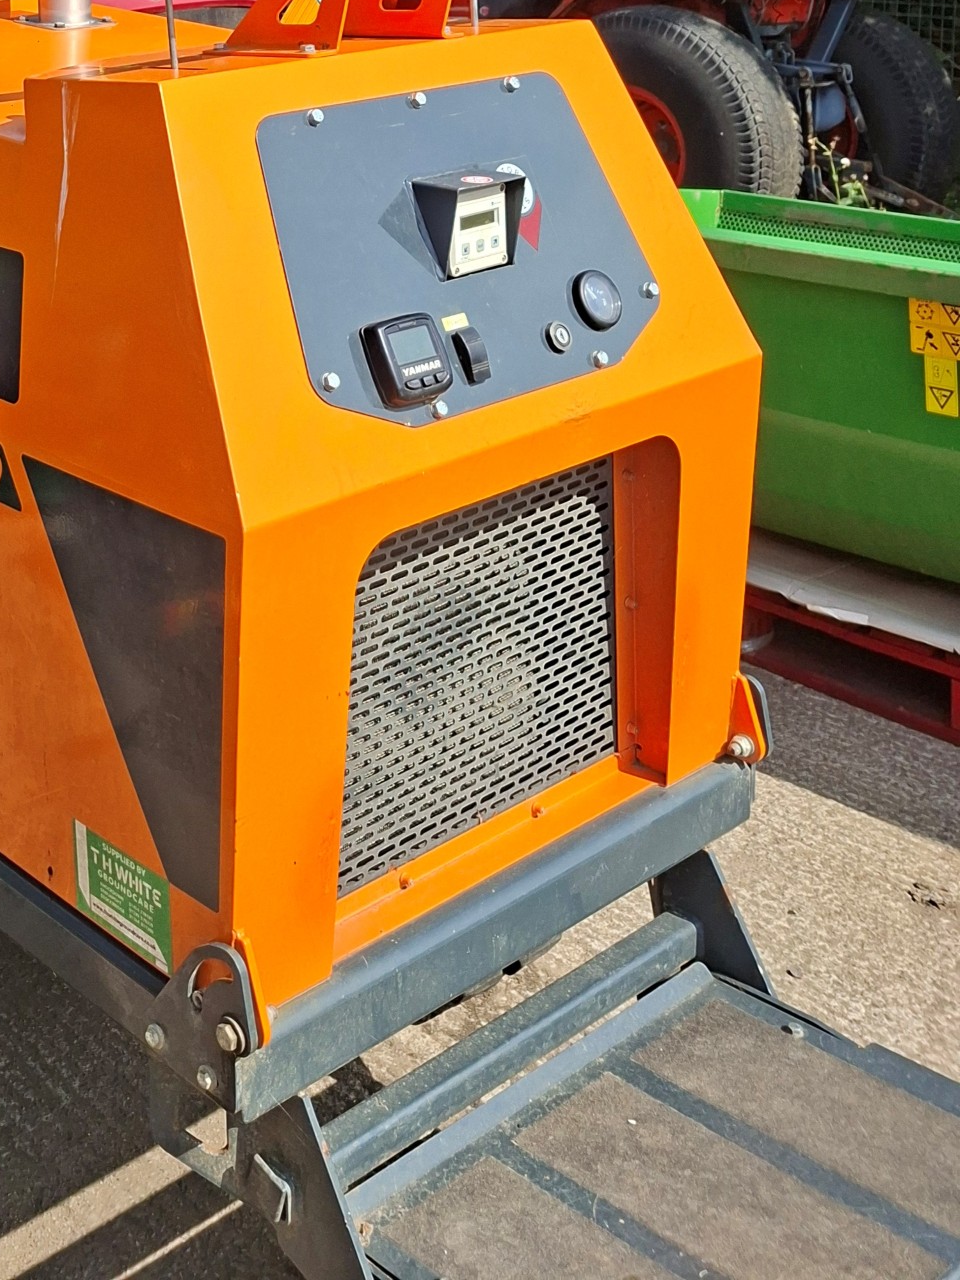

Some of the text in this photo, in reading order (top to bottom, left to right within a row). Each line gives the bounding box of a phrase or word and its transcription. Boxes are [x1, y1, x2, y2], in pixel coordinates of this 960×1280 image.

[402, 359, 441, 377] YANMAR
[102, 842, 146, 877] SUPPLIED BY
[97, 869, 155, 914] GROUNDCARE
[114, 862, 162, 909] WHITE
